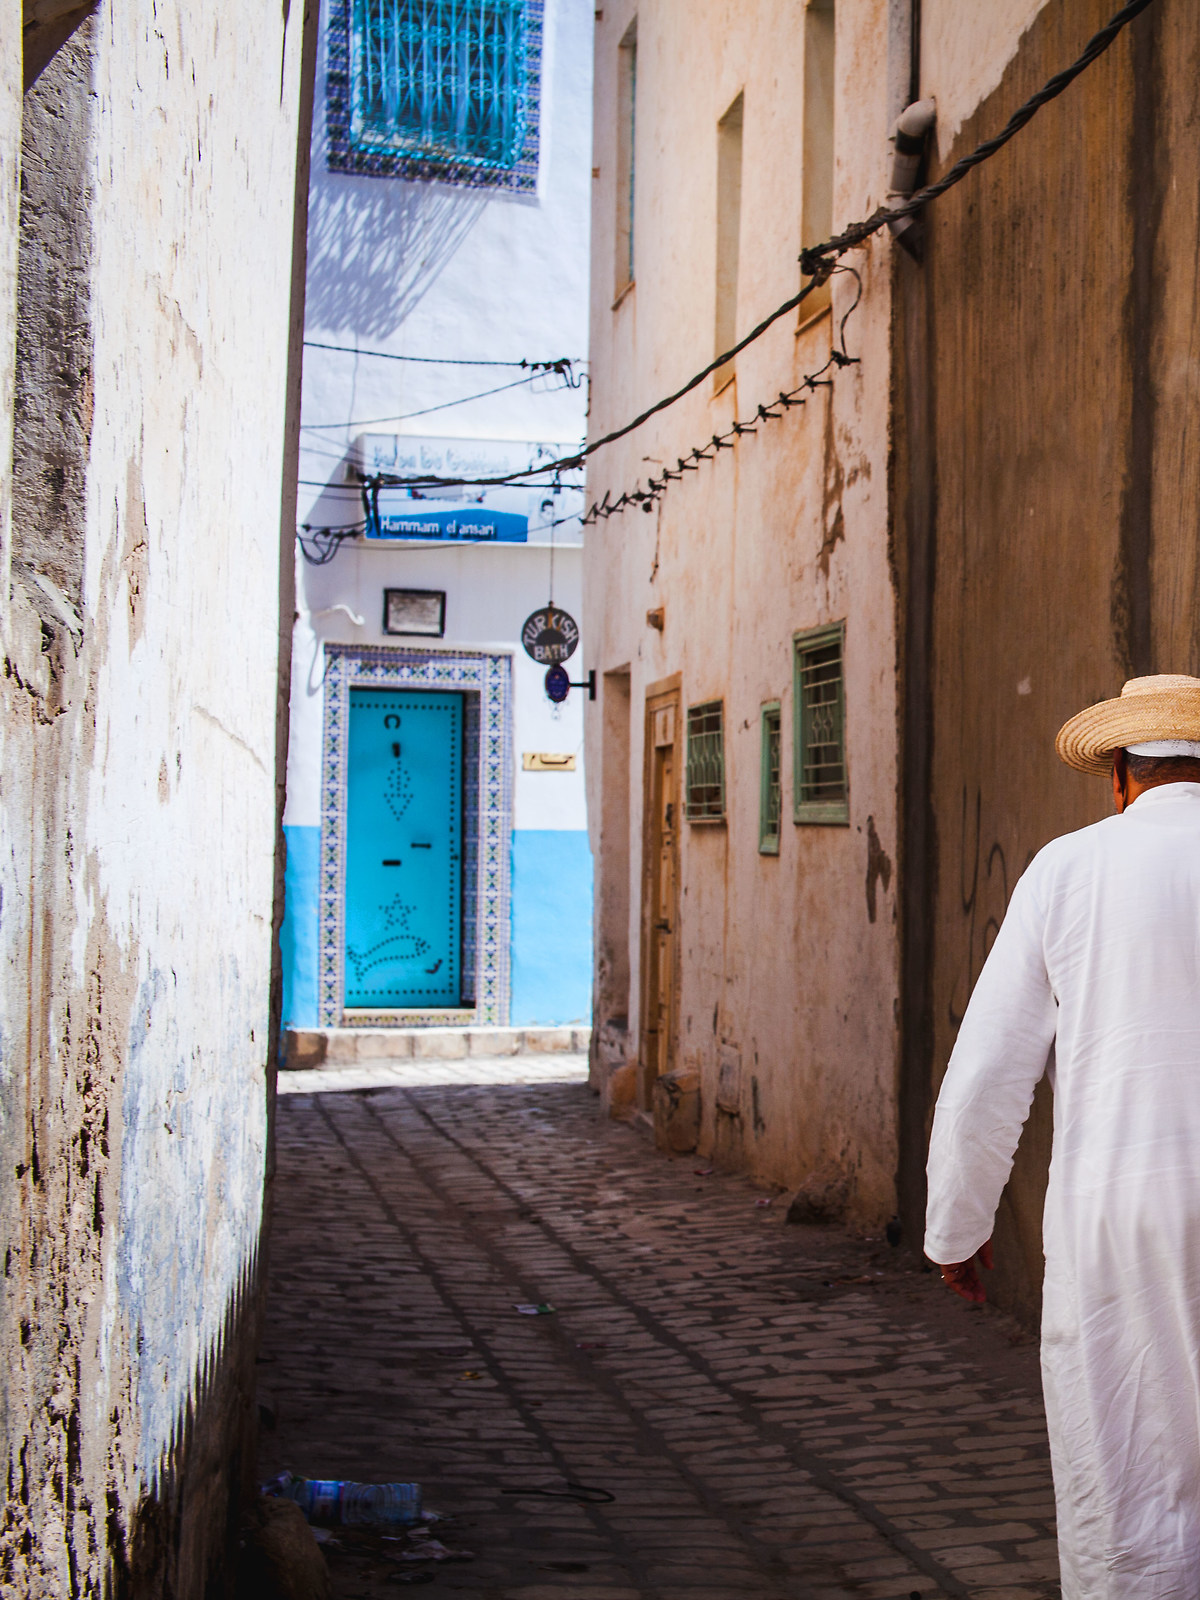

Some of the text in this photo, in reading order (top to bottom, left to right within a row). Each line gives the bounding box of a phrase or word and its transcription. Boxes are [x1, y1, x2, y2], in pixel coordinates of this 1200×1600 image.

[380, 516, 440, 533] Hammam
[446, 519, 457, 534] el
[523, 613, 579, 647] TURKISH
[534, 644, 568, 660] BATH
